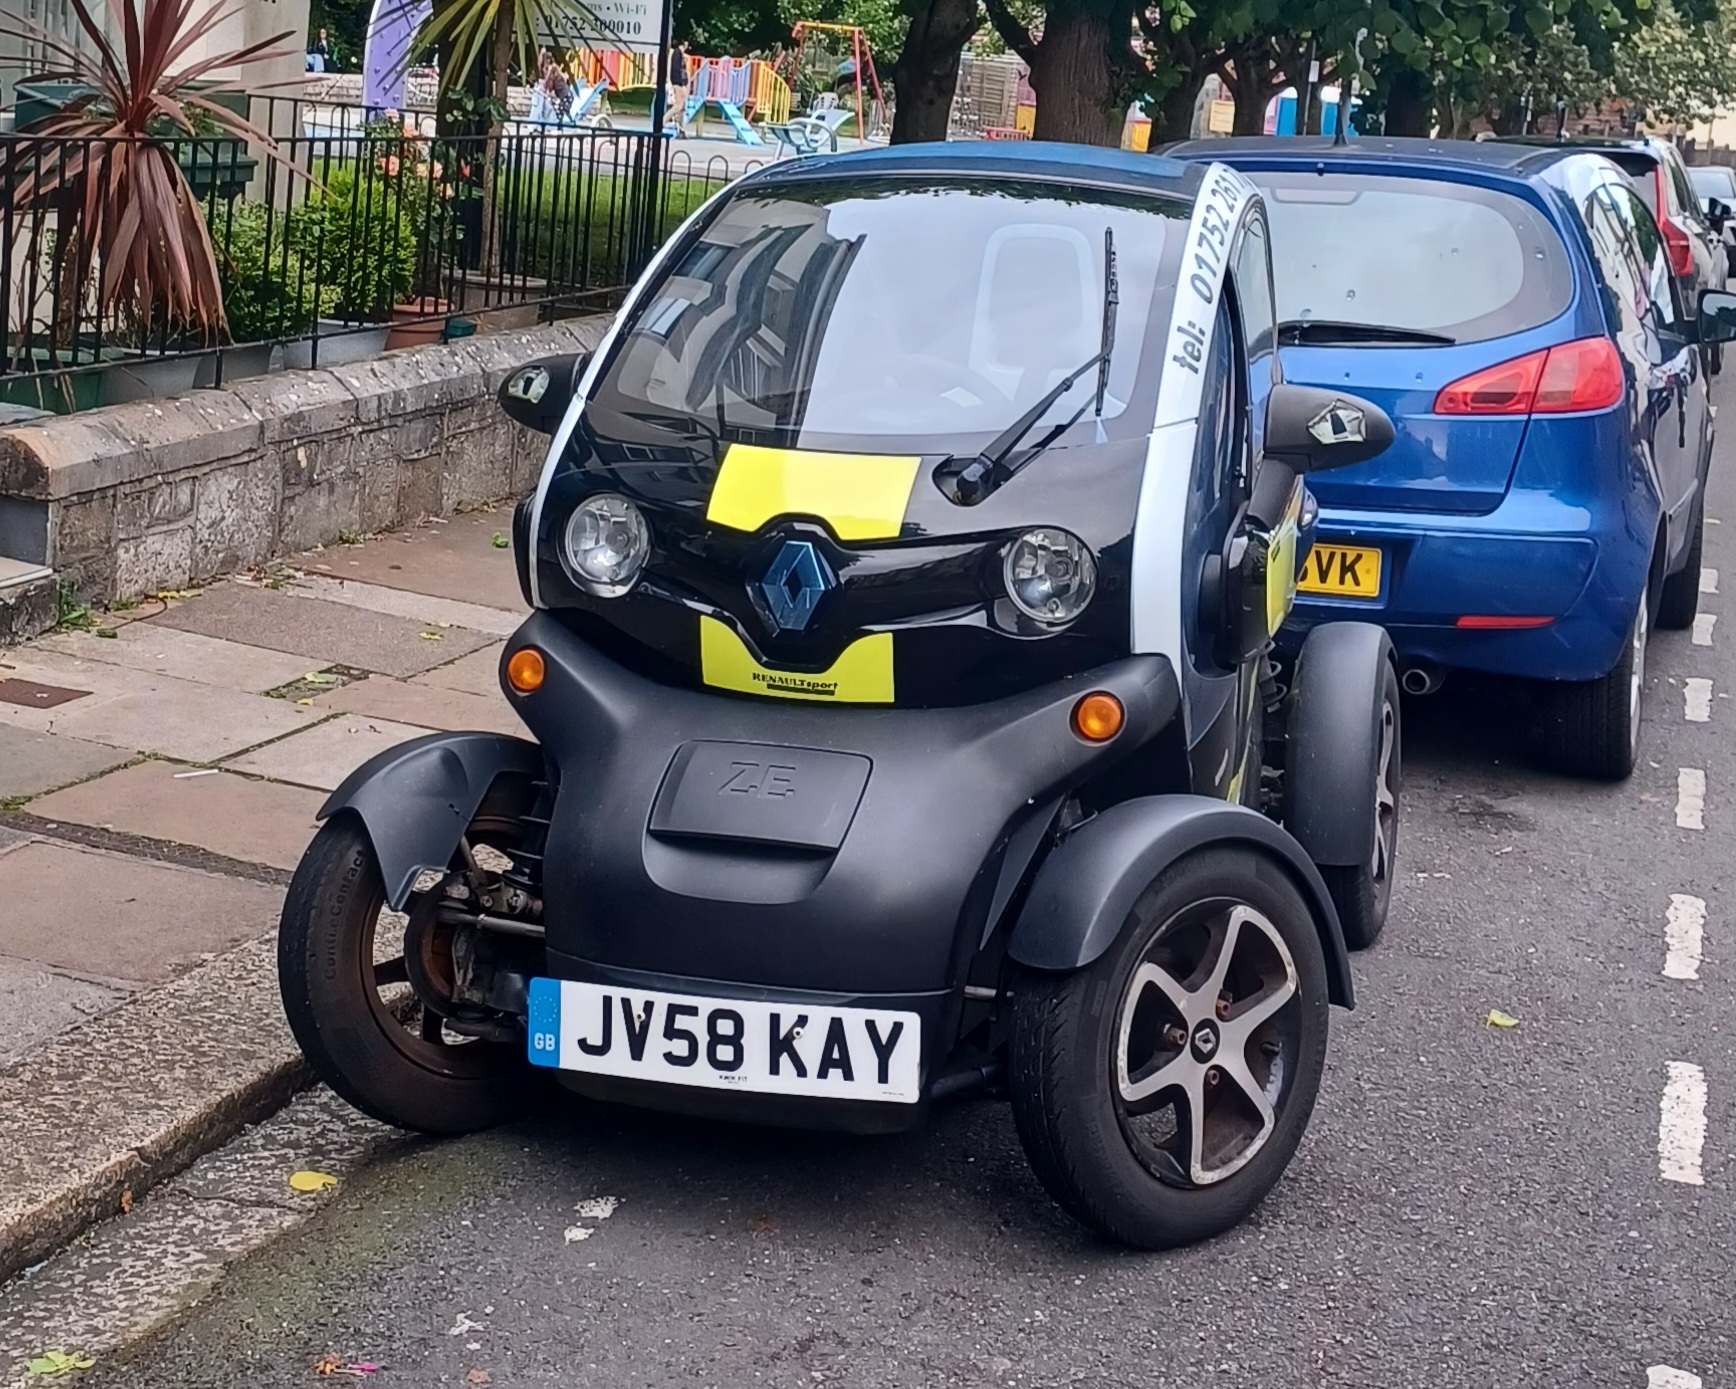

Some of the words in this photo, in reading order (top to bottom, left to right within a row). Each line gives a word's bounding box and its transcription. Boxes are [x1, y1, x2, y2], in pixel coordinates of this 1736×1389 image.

[613, 2, 647, 15] Wi-Fi
[1173, 320, 1206, 375] tel:
[1190, 204, 1230, 305] 01752
[752, 672, 839, 690] RENAULTsport
[533, 1033, 556, 1052] GB
[577, 994, 745, 1072] JV58
[768, 1012, 905, 1085] KAY
